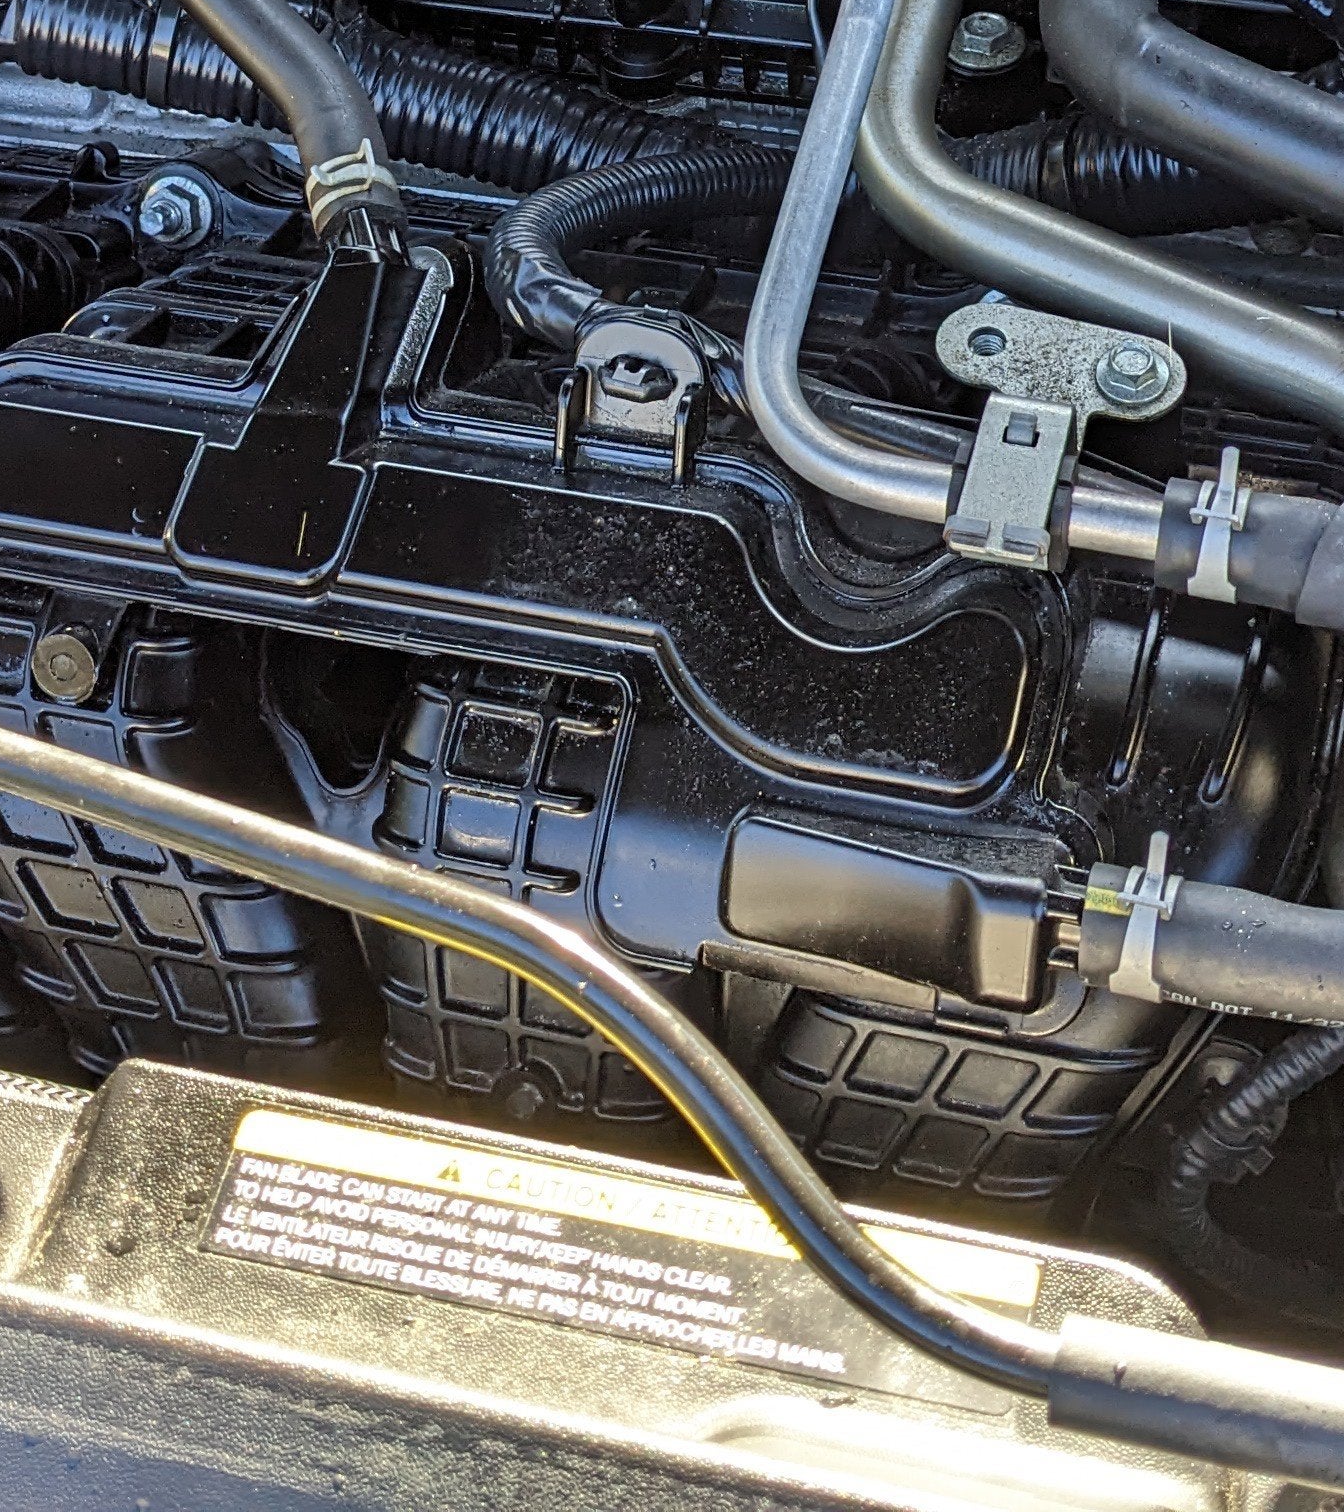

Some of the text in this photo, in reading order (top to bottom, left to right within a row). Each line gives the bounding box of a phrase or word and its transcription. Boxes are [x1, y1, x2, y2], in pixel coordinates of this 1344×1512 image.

[234, 1178, 260, 1200] TO
[260, 1184, 313, 1209] HELP
[309, 1194, 371, 1223] AVOID
[371, 1206, 471, 1244] PERSONAL
[590, 1250, 664, 1282] HANDS
[663, 1264, 733, 1296] CLEAR.
[240, 1157, 279, 1180] FAN
[279, 1164, 343, 1193] BLADE
[342, 1177, 386, 1202] CAN
[385, 1186, 447, 1213] START
[444, 1198, 473, 1219] AT
[471, 1204, 514, 1227] ANY
[486, 1167, 617, 1211] CAUTION
[213, 1226, 273, 1254] POUR
[270, 1233, 337, 1268] ÉVITER
[337, 1250, 404, 1282] TOUTE
[506, 1286, 538, 1309] NE
[537, 1291, 580, 1318] PAS
[578, 1300, 610, 1324] EN
[737, 1334, 777, 1360] LES
[776, 1340, 847, 1375] MAINS.
[221, 1203, 251, 1225] LE
[248, 1208, 371, 1251] VENTILATEUR
[368, 1231, 444, 1266] RISQUE
[443, 1248, 474, 1272] DE
[473, 1253, 582, 1294] DÉMARRER
[580, 1271, 600, 1297] À
[600, 1279, 655, 1308] TOUT
